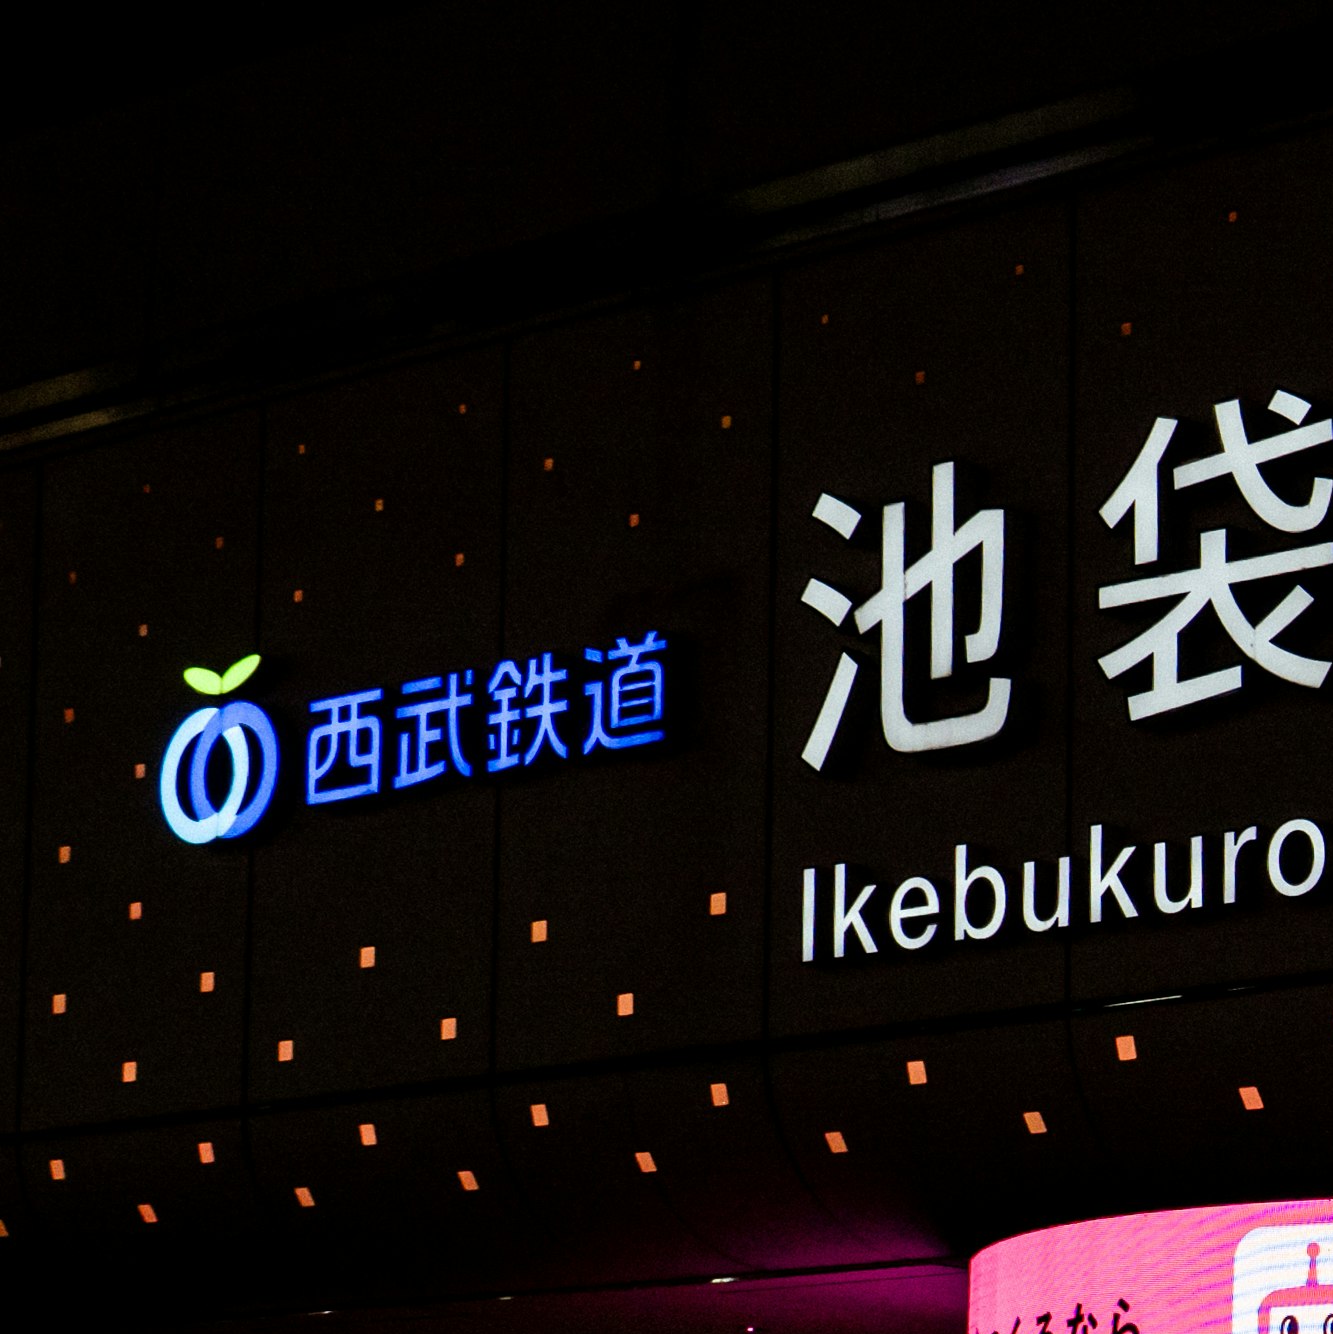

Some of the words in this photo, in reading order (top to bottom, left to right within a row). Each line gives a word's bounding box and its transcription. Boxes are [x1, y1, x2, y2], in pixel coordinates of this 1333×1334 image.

[305, 630, 668, 806] 西武鉄道
[802, 818, 1326, 963] Ikebukuro
